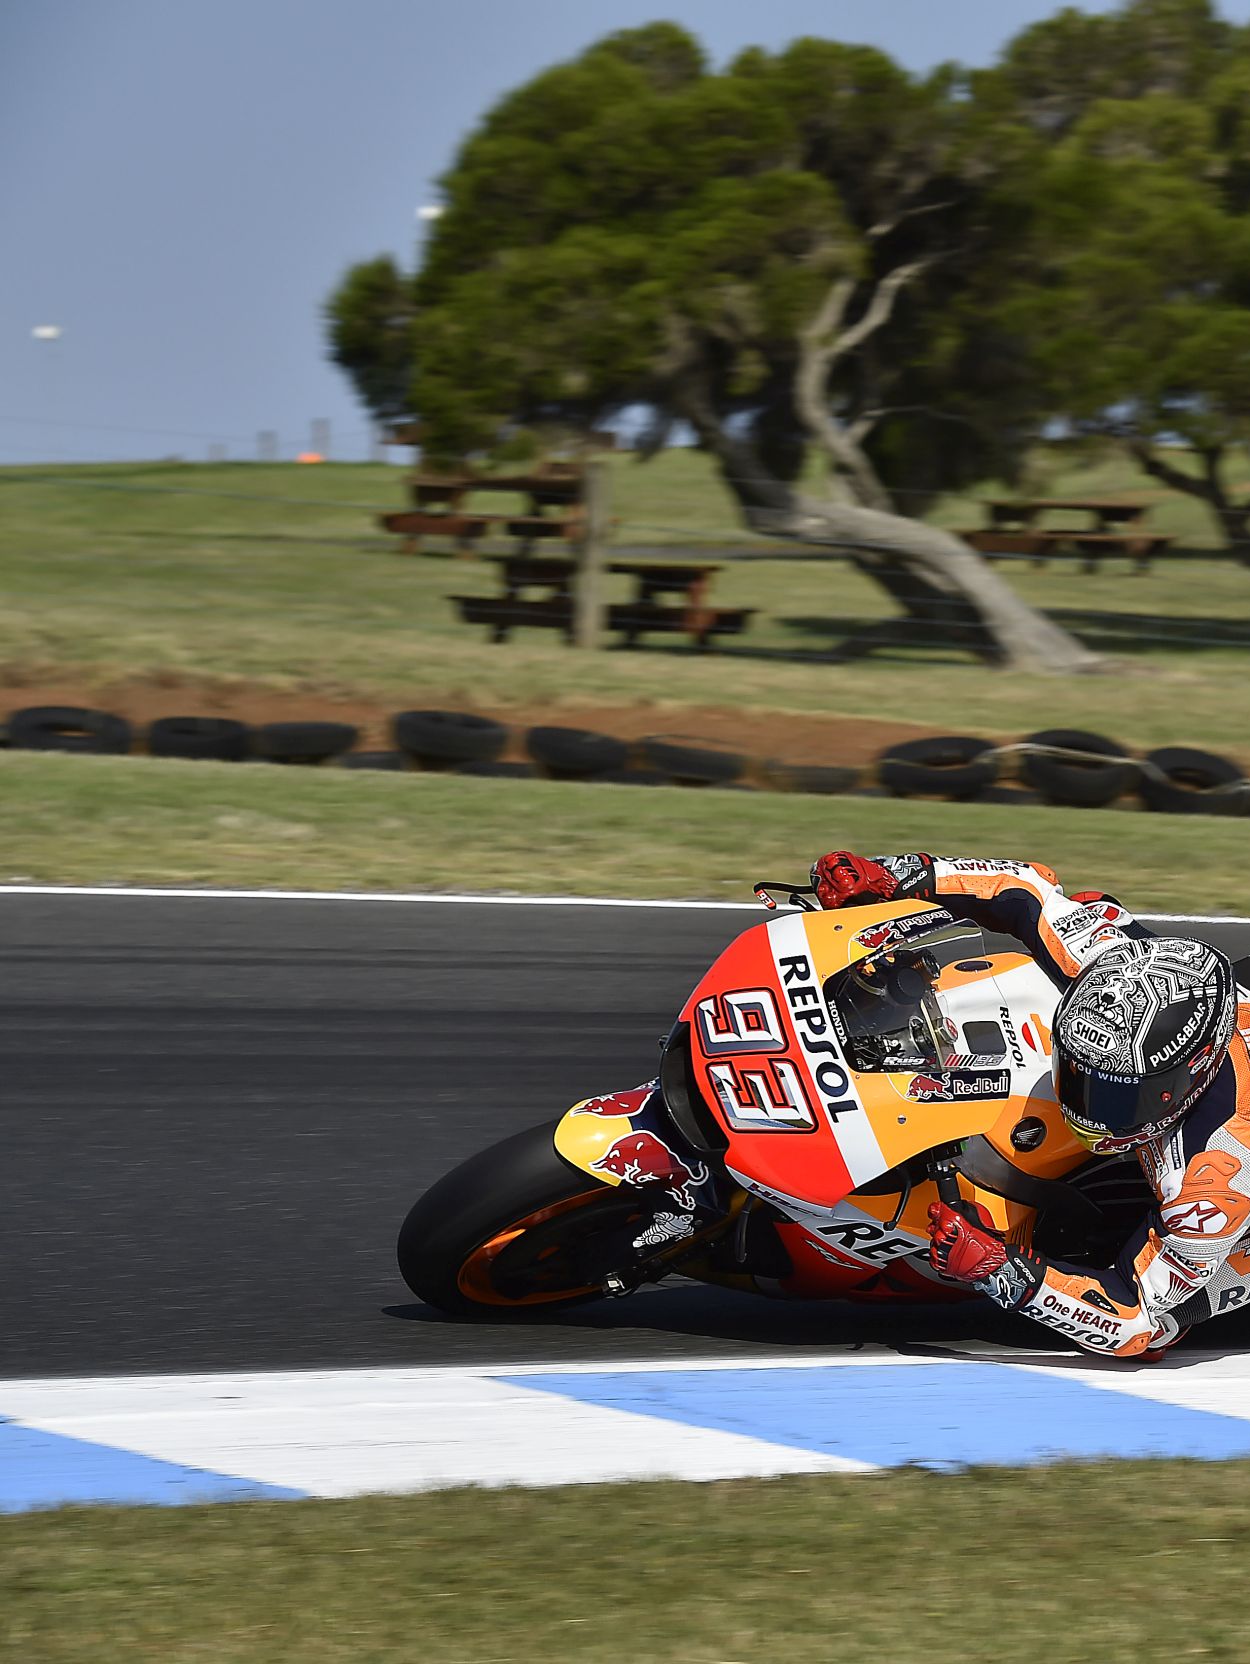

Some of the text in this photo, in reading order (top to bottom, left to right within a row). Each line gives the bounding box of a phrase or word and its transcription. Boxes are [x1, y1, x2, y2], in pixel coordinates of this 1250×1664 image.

[778, 955, 860, 1124] REPSOL
[827, 998, 848, 1048] HONDA
[1000, 1005, 1027, 1070] REPSOL
[1073, 1020, 1112, 1050] SHOEI
[1150, 1001, 1207, 1068] PULL&BEAR
[693, 986, 820, 1134] 93
[1071, 1059, 1140, 1085] YOU WINGS
[1062, 1103, 1108, 1132] PULL&BEAR
[1020, 1304, 1122, 1350] REPSOL
[1043, 1294, 1071, 1316] One
[1071, 1307, 1122, 1336] HEART.
